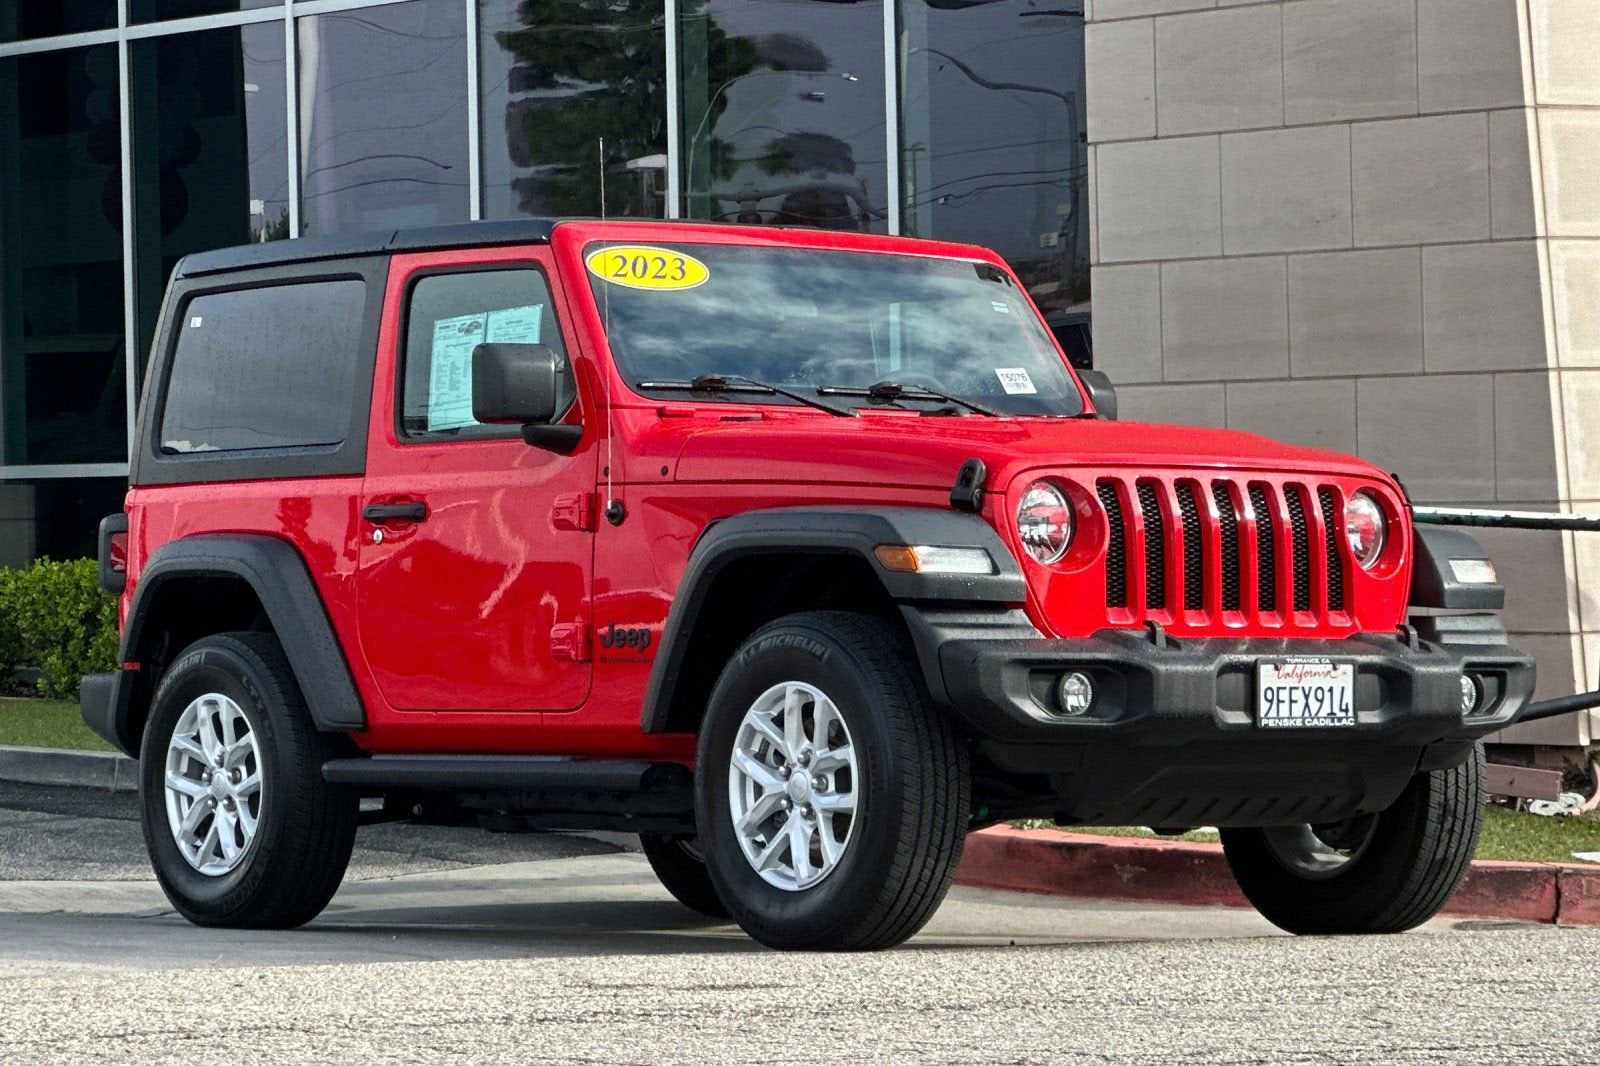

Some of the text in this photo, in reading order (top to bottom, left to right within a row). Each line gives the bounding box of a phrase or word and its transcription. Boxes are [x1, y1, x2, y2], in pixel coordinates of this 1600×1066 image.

[612, 255, 686, 281] 2023
[601, 622, 651, 653] Jeep
[760, 634, 827, 657] MICHELIN
[1276, 663, 1338, 684] California
[1264, 686, 1349, 717] 9FFX914
[1261, 718, 1355, 727] PENSKE CADILLAC
